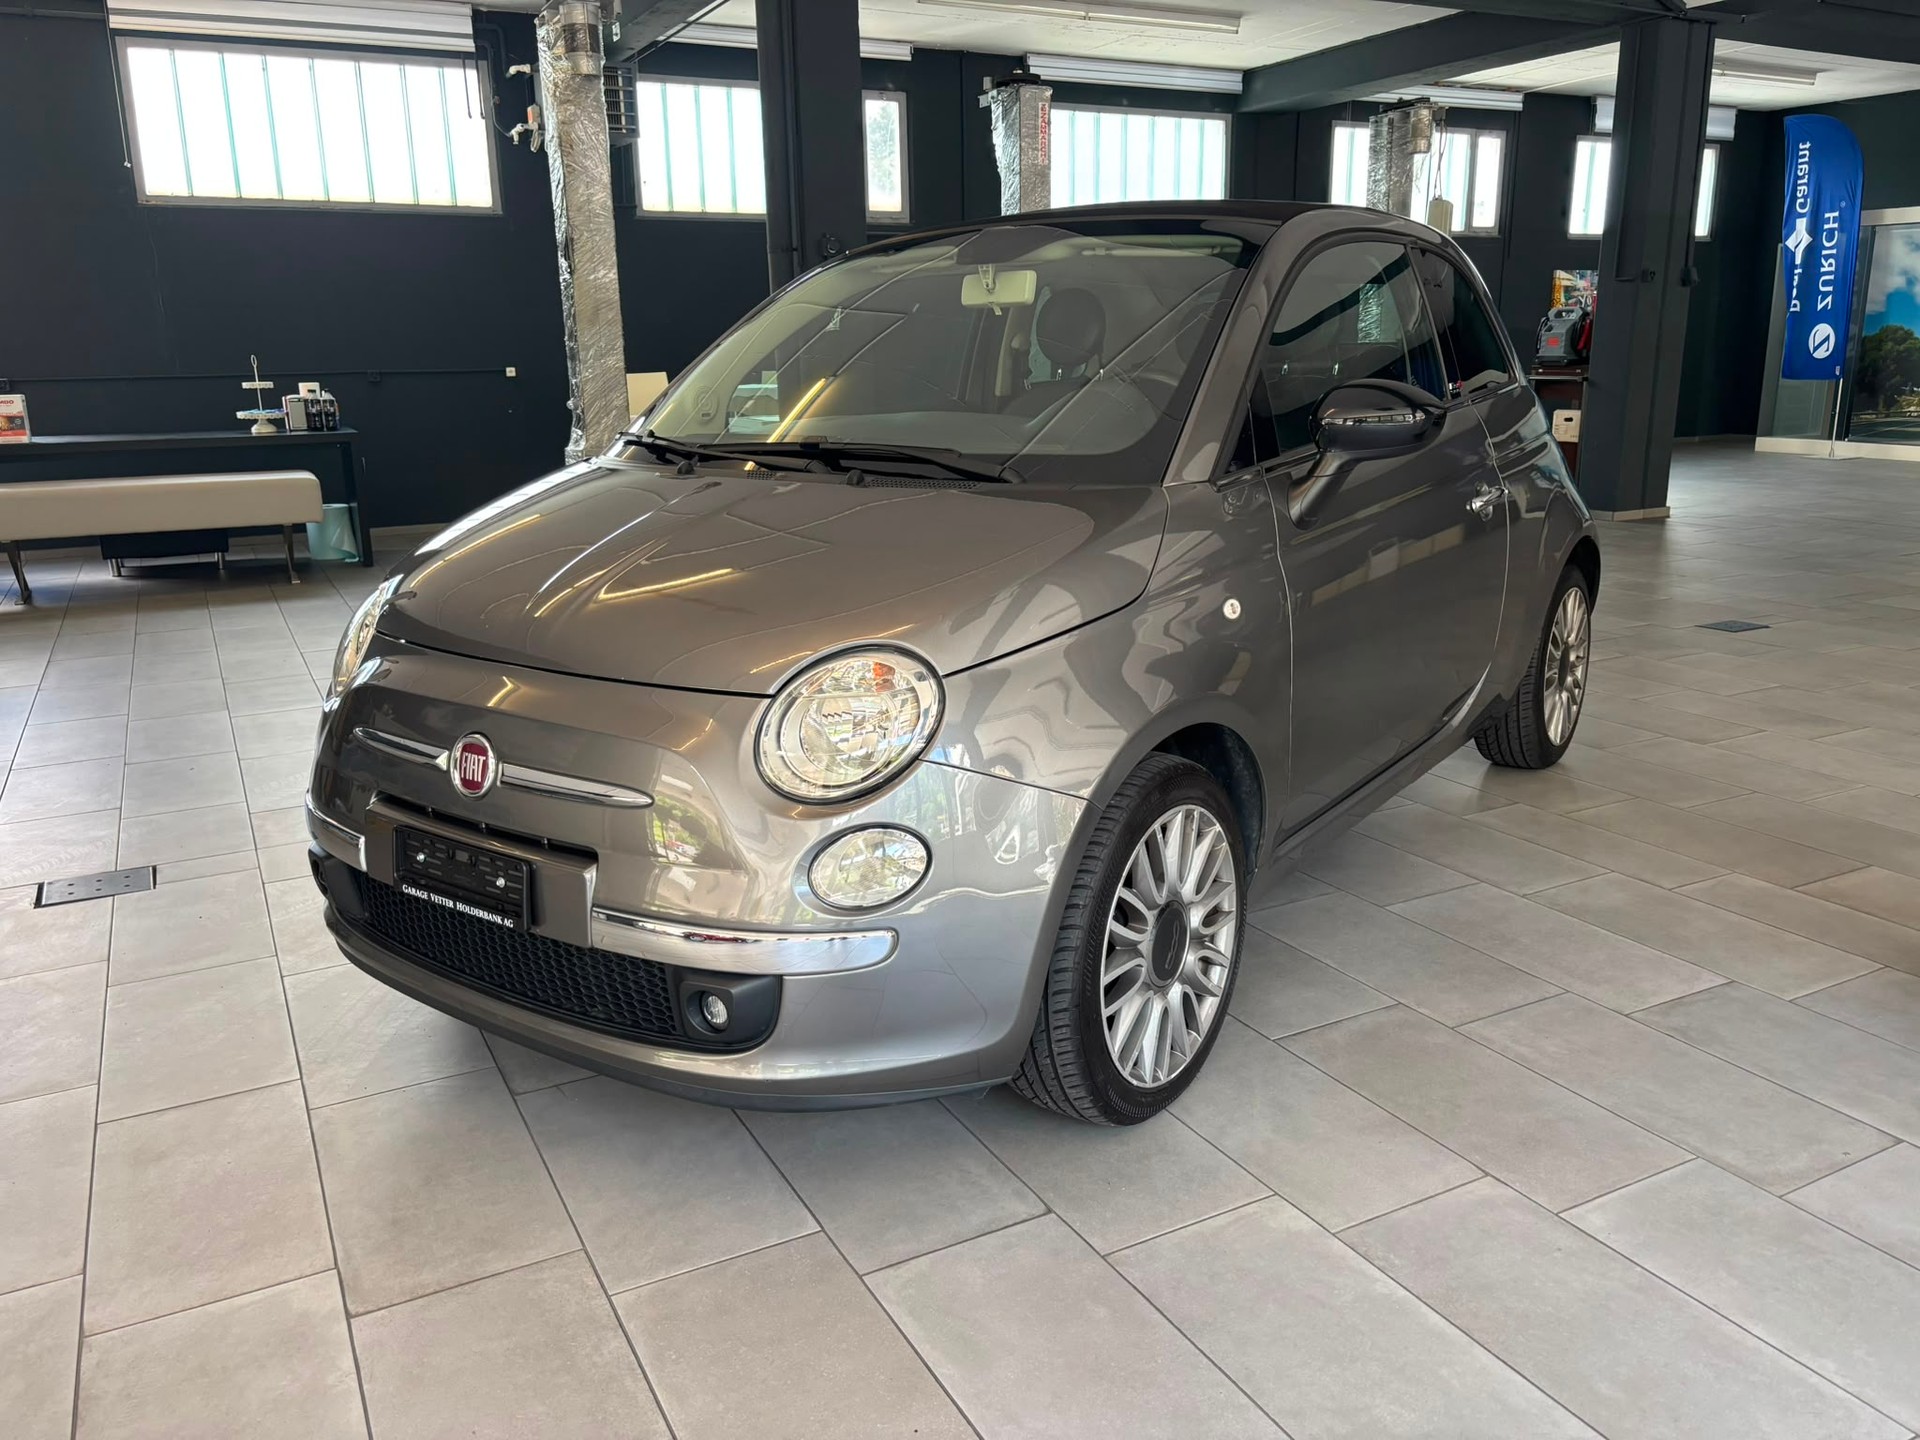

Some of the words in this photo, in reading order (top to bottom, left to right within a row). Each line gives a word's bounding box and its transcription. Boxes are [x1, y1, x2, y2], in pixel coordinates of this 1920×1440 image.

[461, 751, 487, 783] FIAT
[402, 884, 429, 900] GARAGE
[430, 892, 454, 909] VETTER
[456, 901, 503, 925] HOLDERBANK
[503, 917, 514, 928] AG
